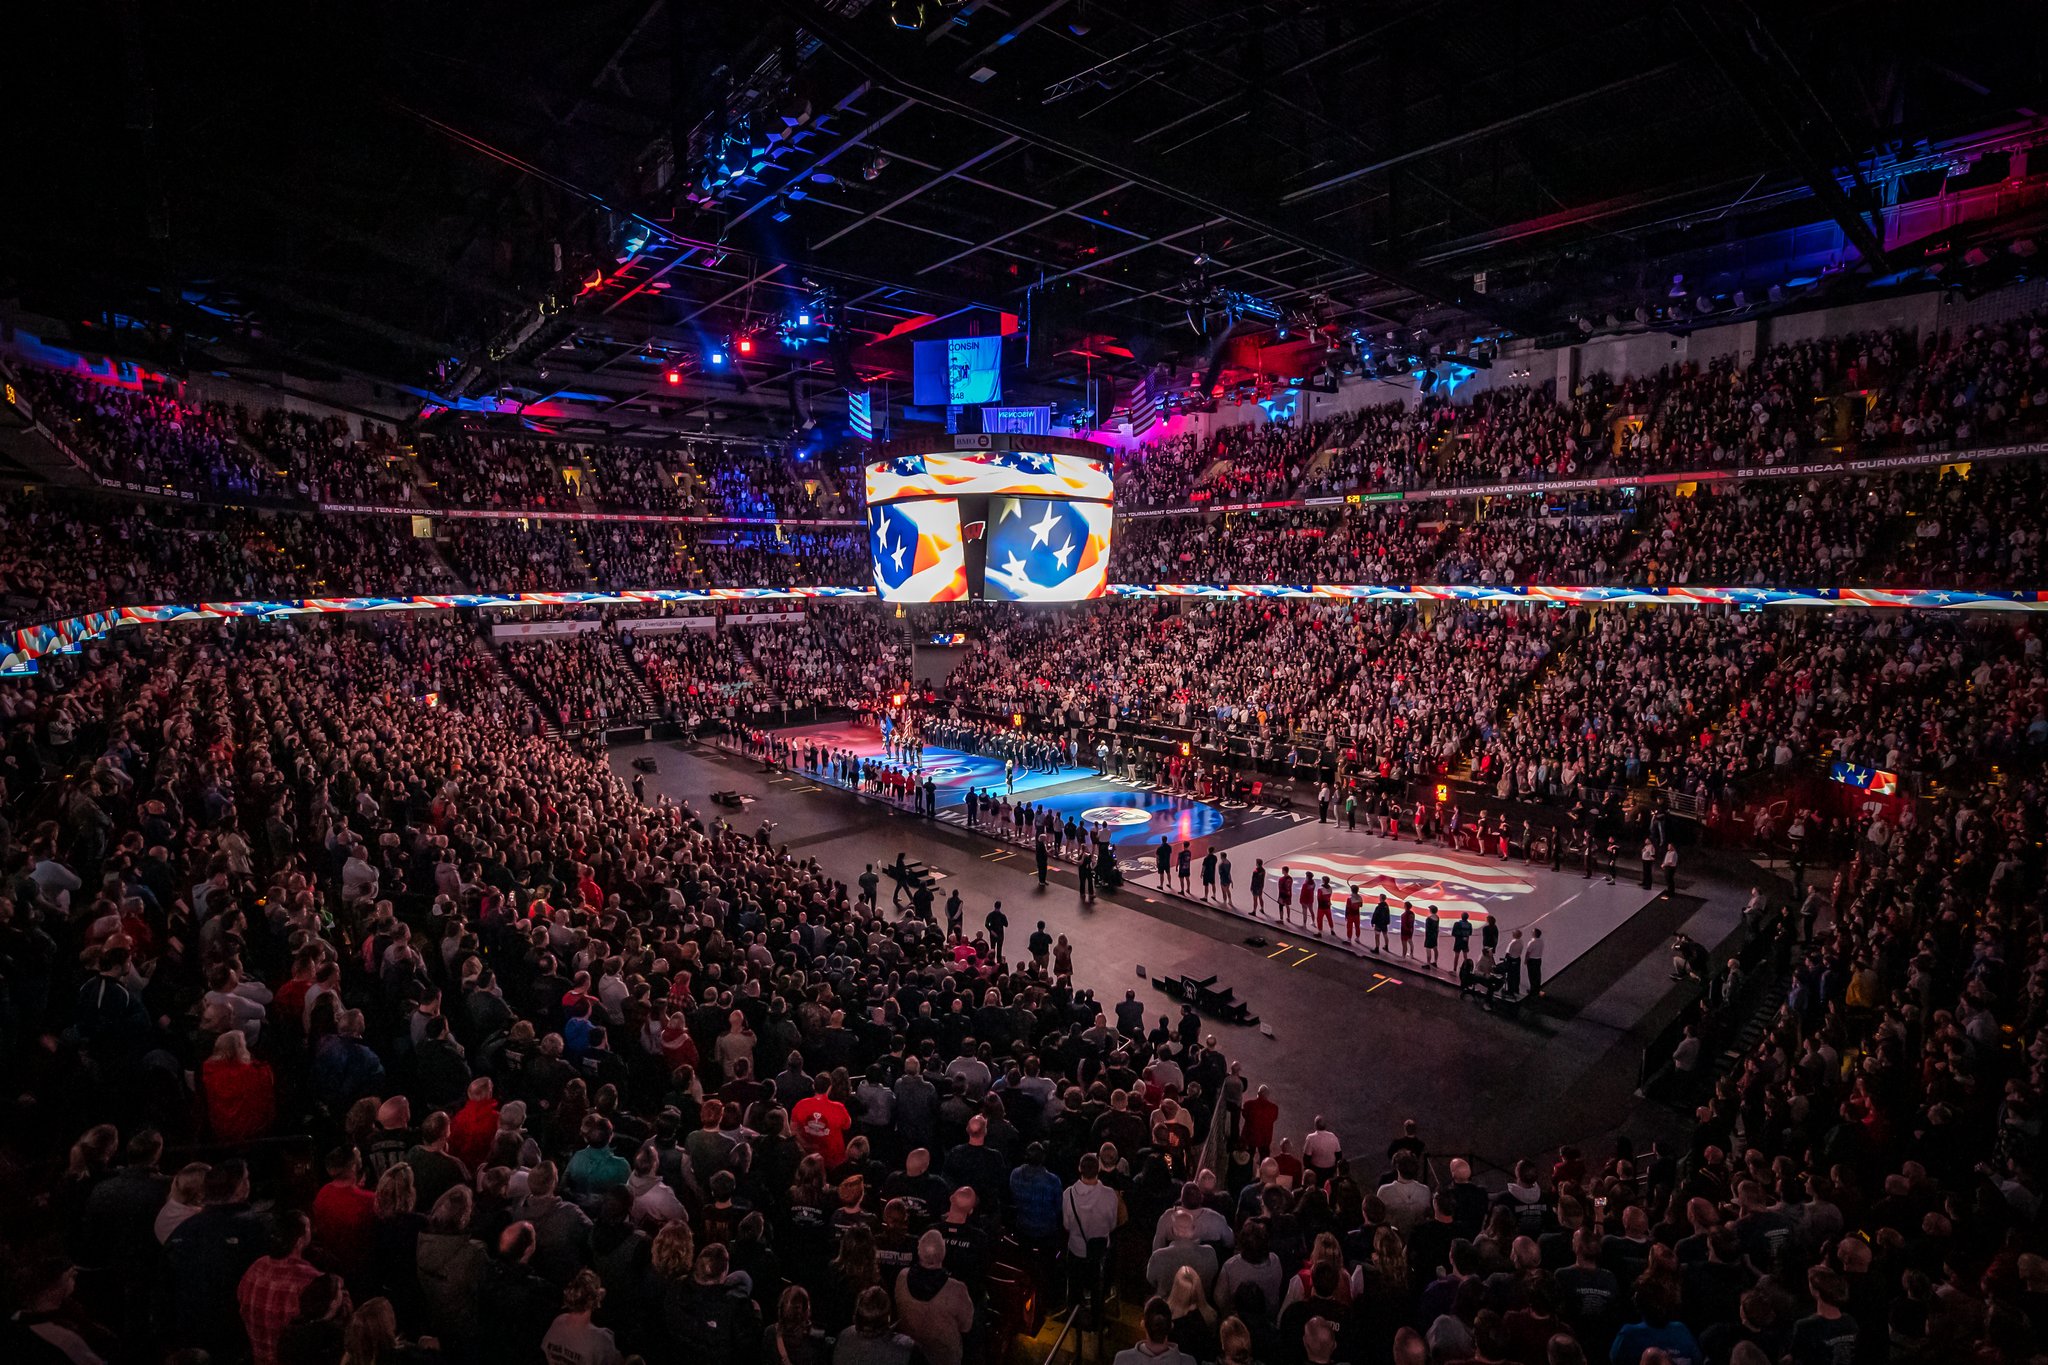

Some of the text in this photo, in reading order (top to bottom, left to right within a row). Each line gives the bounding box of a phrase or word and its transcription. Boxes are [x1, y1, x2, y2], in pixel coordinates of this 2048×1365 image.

[956, 437, 976, 445] BMO
[1738, 469, 1754, 477] 26
[1758, 466, 1799, 476] MEN'S
[1803, 463, 1844, 474] NCAA
[1849, 453, 1951, 470] TOURNAMENT
[102, 478, 122, 488] FOUR
[1430, 477, 1638, 497] MEN'S NCAA NATIONAL CHAMPIONS 1941
[324, 504, 355, 512] MEN'S
[394, 507, 444, 516] CHAMPIONS
[1128, 510, 1165, 518] TOURNAMENT
[1166, 507, 1199, 515] CHAMPIONS
[959, 1240, 971, 1249] LIFE
